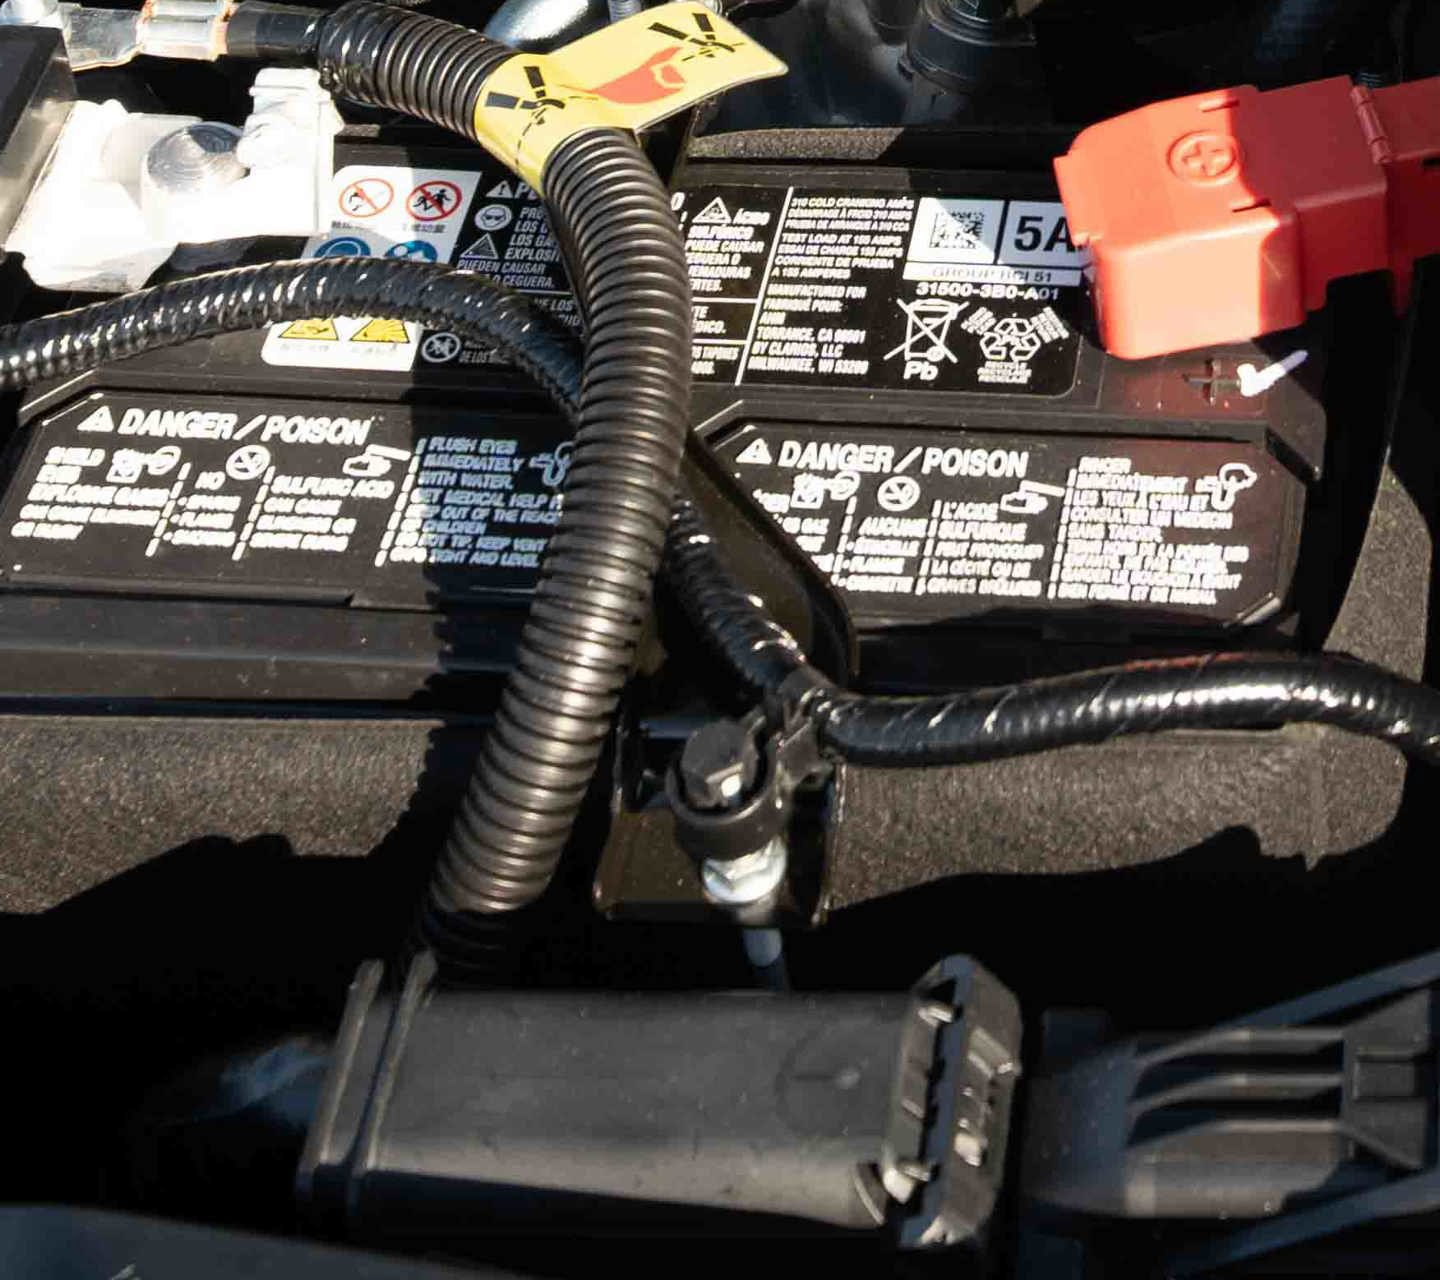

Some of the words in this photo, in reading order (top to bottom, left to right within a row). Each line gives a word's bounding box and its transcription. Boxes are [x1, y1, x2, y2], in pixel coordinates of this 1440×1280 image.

[809, 198, 836, 207] COLD
[838, 198, 885, 208] CRANKING
[887, 197, 914, 209] AMPS
[887, 210, 912, 220] AMPS
[781, 233, 806, 244] TEST
[808, 234, 837, 244] LOAD
[838, 235, 852, 244] AT
[872, 235, 902, 246] AMPS
[721, 242, 764, 253] CAUSAR
[820, 246, 859, 256] CHARGE
[876, 247, 903, 258] AMPS
[500, 263, 546, 275] CAUSAR
[775, 256, 835, 267] CORRIENTE
[837, 257, 850, 267] DE
[852, 258, 894, 269] PRUEBA
[1033, 272, 1052, 282] 51
[767, 283, 844, 298] MANUFACTURED
[916, 282, 1059, 300] 31500-3B0-A01
[757, 326, 815, 342] TORRANCE,
[818, 330, 833, 342] CA
[752, 341, 767, 355] BY
[821, 345, 844, 357] LLC
[818, 360, 834, 373] WI
[904, 360, 938, 381] Pb
[428, 437, 478, 453] FLUSH
[479, 439, 518, 455] EYES
[423, 454, 525, 472] IMMEDIATELY
[194, 470, 226, 490] NO
[418, 471, 457, 486] WITH
[271, 474, 354, 497] SULFURIC
[351, 479, 395, 499] ACID
[443, 489, 505, 507] MEDICAL
[509, 492, 548, 509] HELP
[441, 507, 469, 520] OUT
[472, 508, 490, 521] OF
[493, 509, 520, 522] THE
[422, 520, 488, 535] CHILDREN
[859, 517, 929, 538] AUCUNE
[475, 537, 512, 551] KEEP
